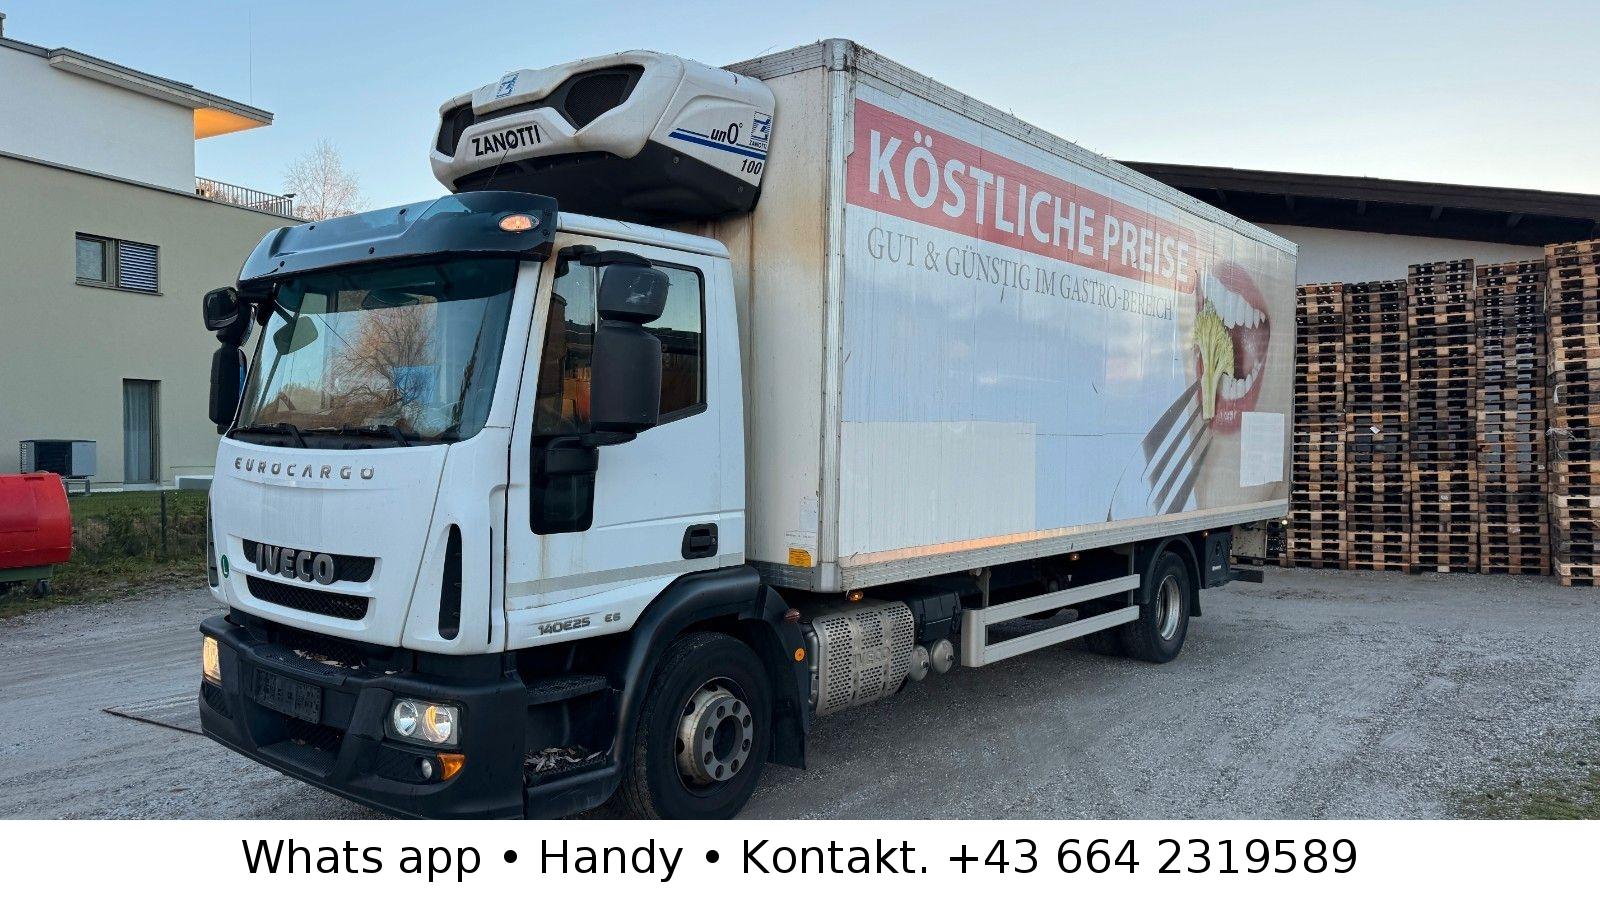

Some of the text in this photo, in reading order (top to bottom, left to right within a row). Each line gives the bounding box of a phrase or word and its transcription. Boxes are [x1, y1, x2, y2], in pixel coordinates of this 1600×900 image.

[471, 125, 541, 156] ZANOTTI
[741, 158, 762, 175] 100
[868, 130, 1190, 282] KÖSTLICHE PREISE
[867, 226, 1173, 321] GUT & GÜNSTIG IM GASTRO-BEREICH
[234, 457, 375, 480] EUROCARGO
[255, 543, 335, 585] IVECO
[538, 612, 621, 635] 140E25 E6
